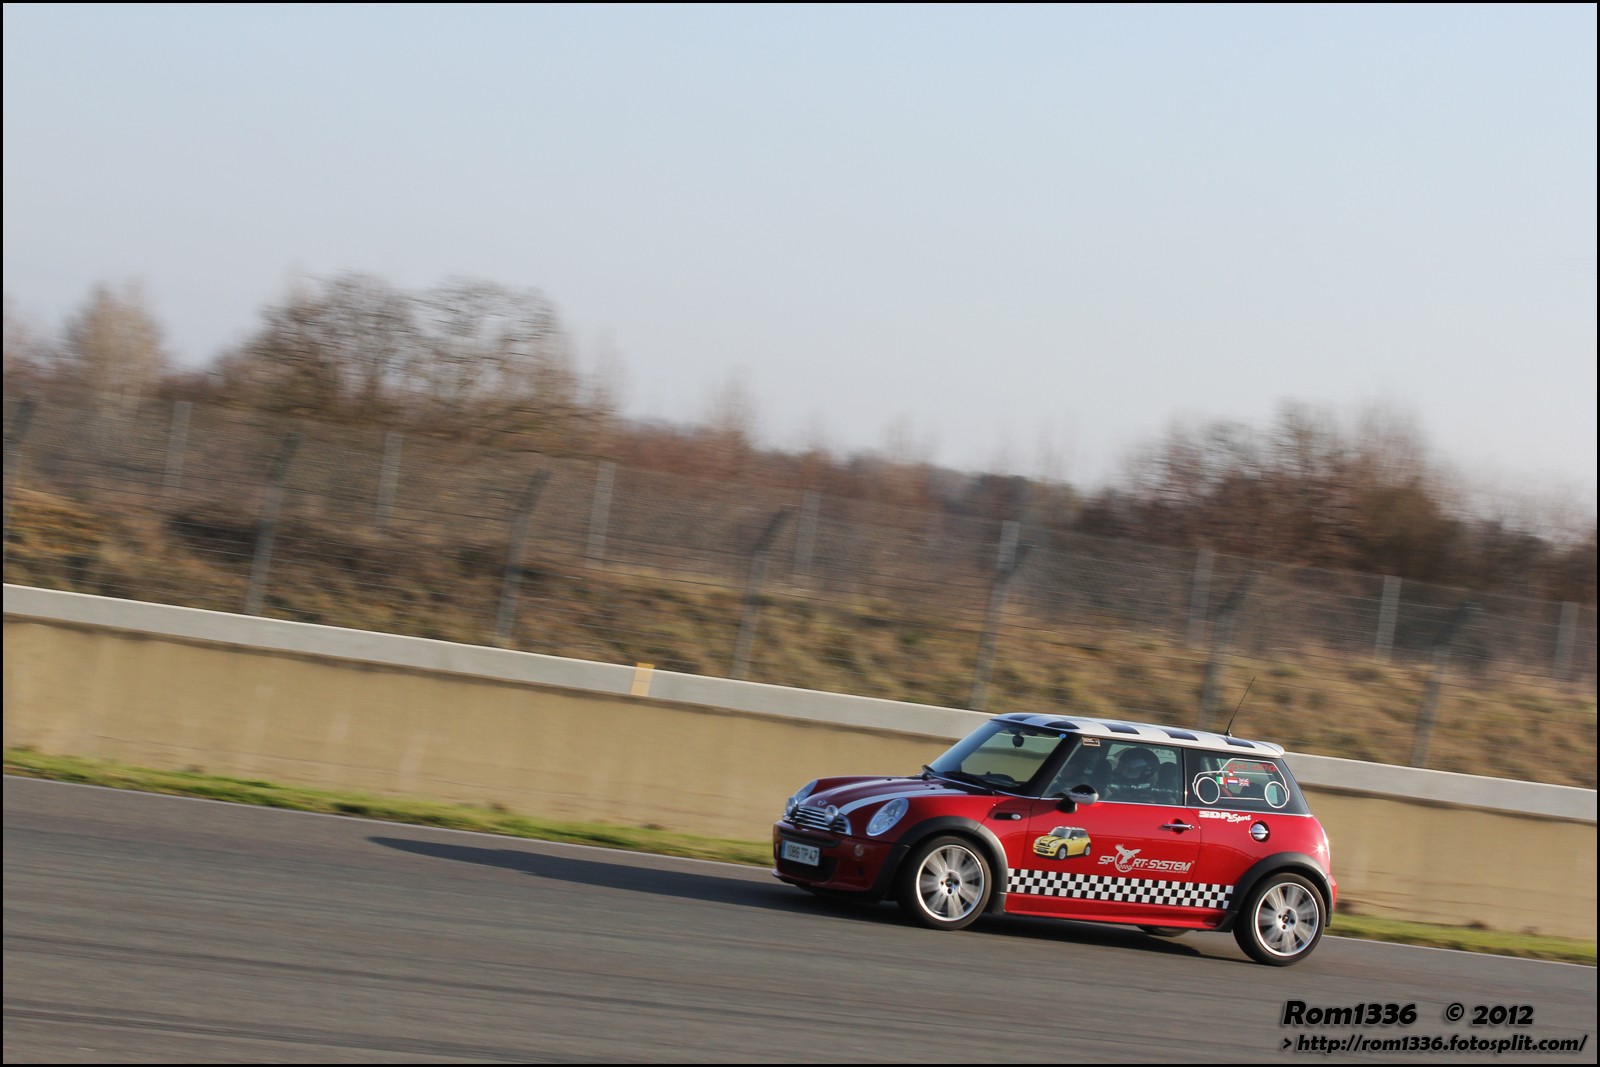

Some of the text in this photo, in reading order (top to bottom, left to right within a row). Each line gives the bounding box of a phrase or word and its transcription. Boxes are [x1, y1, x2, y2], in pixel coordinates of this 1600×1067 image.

[1227, 812, 1252, 824] Sport
[801, 847, 808, 859] TP
[809, 849, 817, 862] 47
